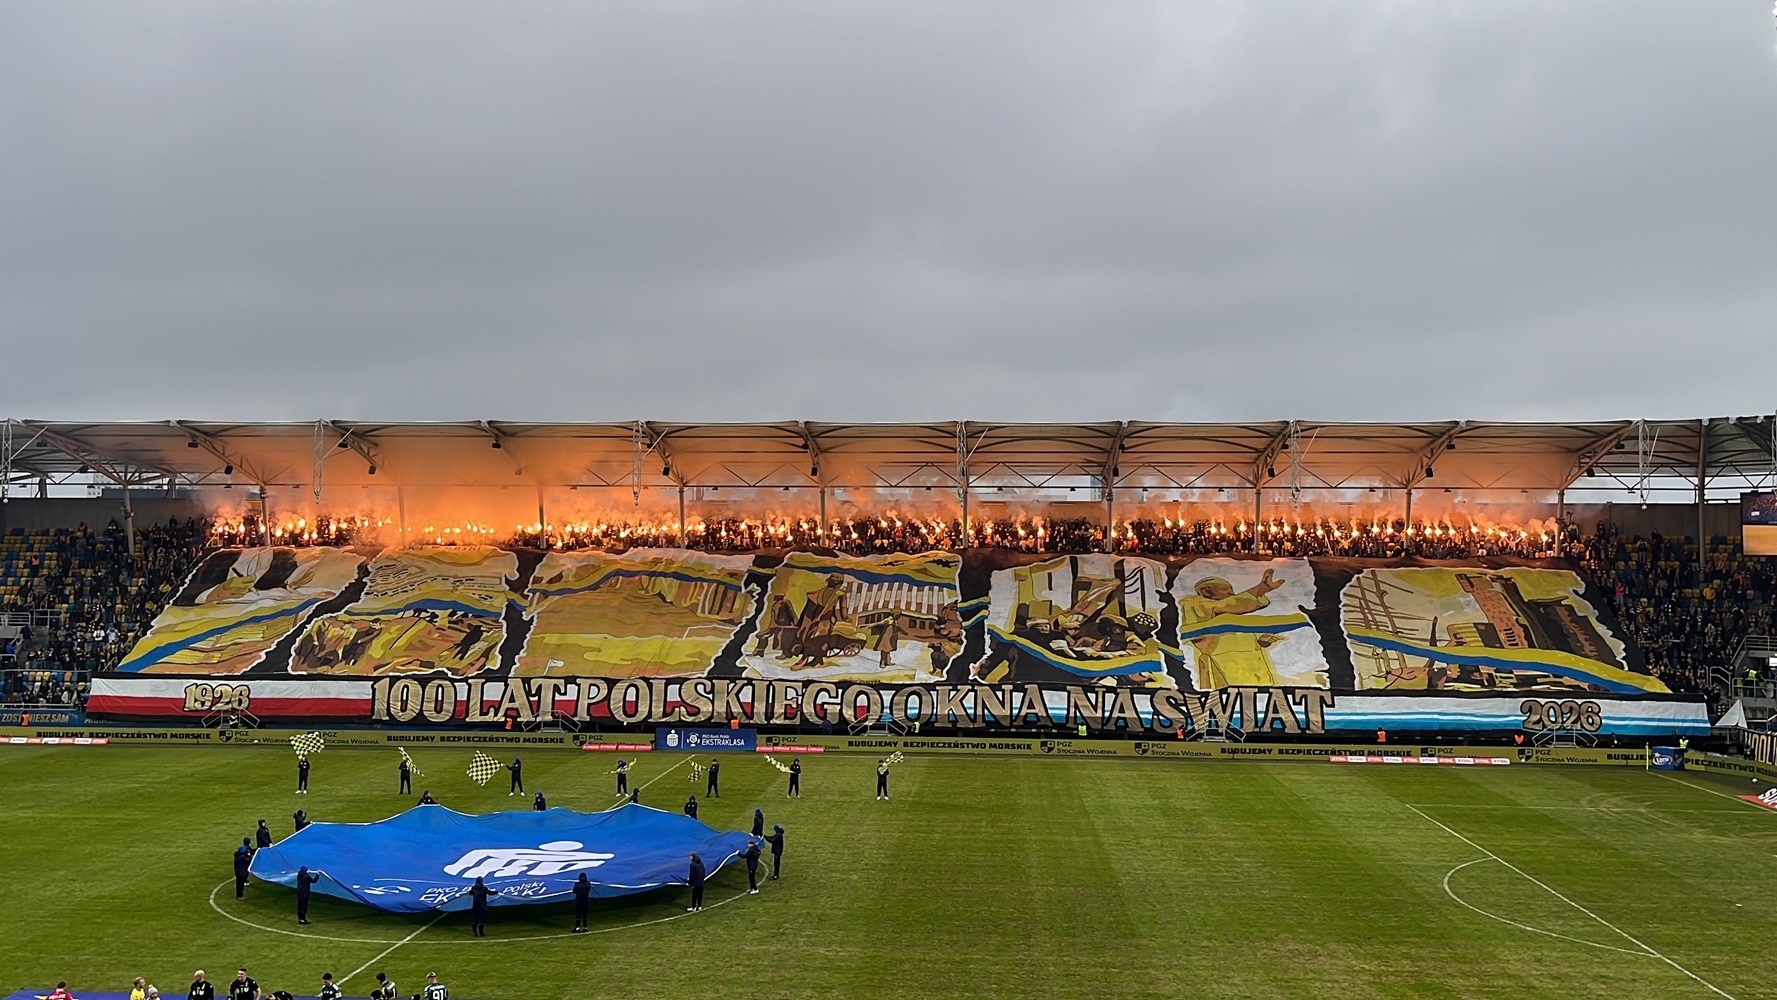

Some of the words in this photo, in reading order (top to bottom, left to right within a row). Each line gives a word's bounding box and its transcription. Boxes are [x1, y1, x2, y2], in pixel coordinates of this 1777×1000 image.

[184, 683, 250, 711] 1926
[371, 677, 455, 722] 100
[465, 678, 565, 722] LAT
[576, 678, 882, 727] POLSKIEGO
[892, 684, 1053, 728] OKNA
[1066, 685, 1145, 732] NA
[2, 713, 50, 723] ZOSTNIESZ
[51, 713, 69, 723] SAM
[1521, 700, 1601, 731] 2026
[89, 730, 168, 739] BEZPIECZEŃSTWO
[170, 732, 211, 740] MORSKIE
[440, 735, 521, 743] BEZPIECZEŃSTWO
[848, 740, 898, 748] BUDUJEMY
[903, 741, 987, 750] BEZPIECZEŃSTWO
[989, 742, 1032, 750] MORSKIE
[1221, 747, 1273, 755] BUDUJEMY
[1278, 747, 1364, 756] BEZPIECZEŃSTWO
[1367, 749, 1412, 757] MORSKIE
[425, 886, 458, 894] PKO
[432, 990, 444, 1000] 91
